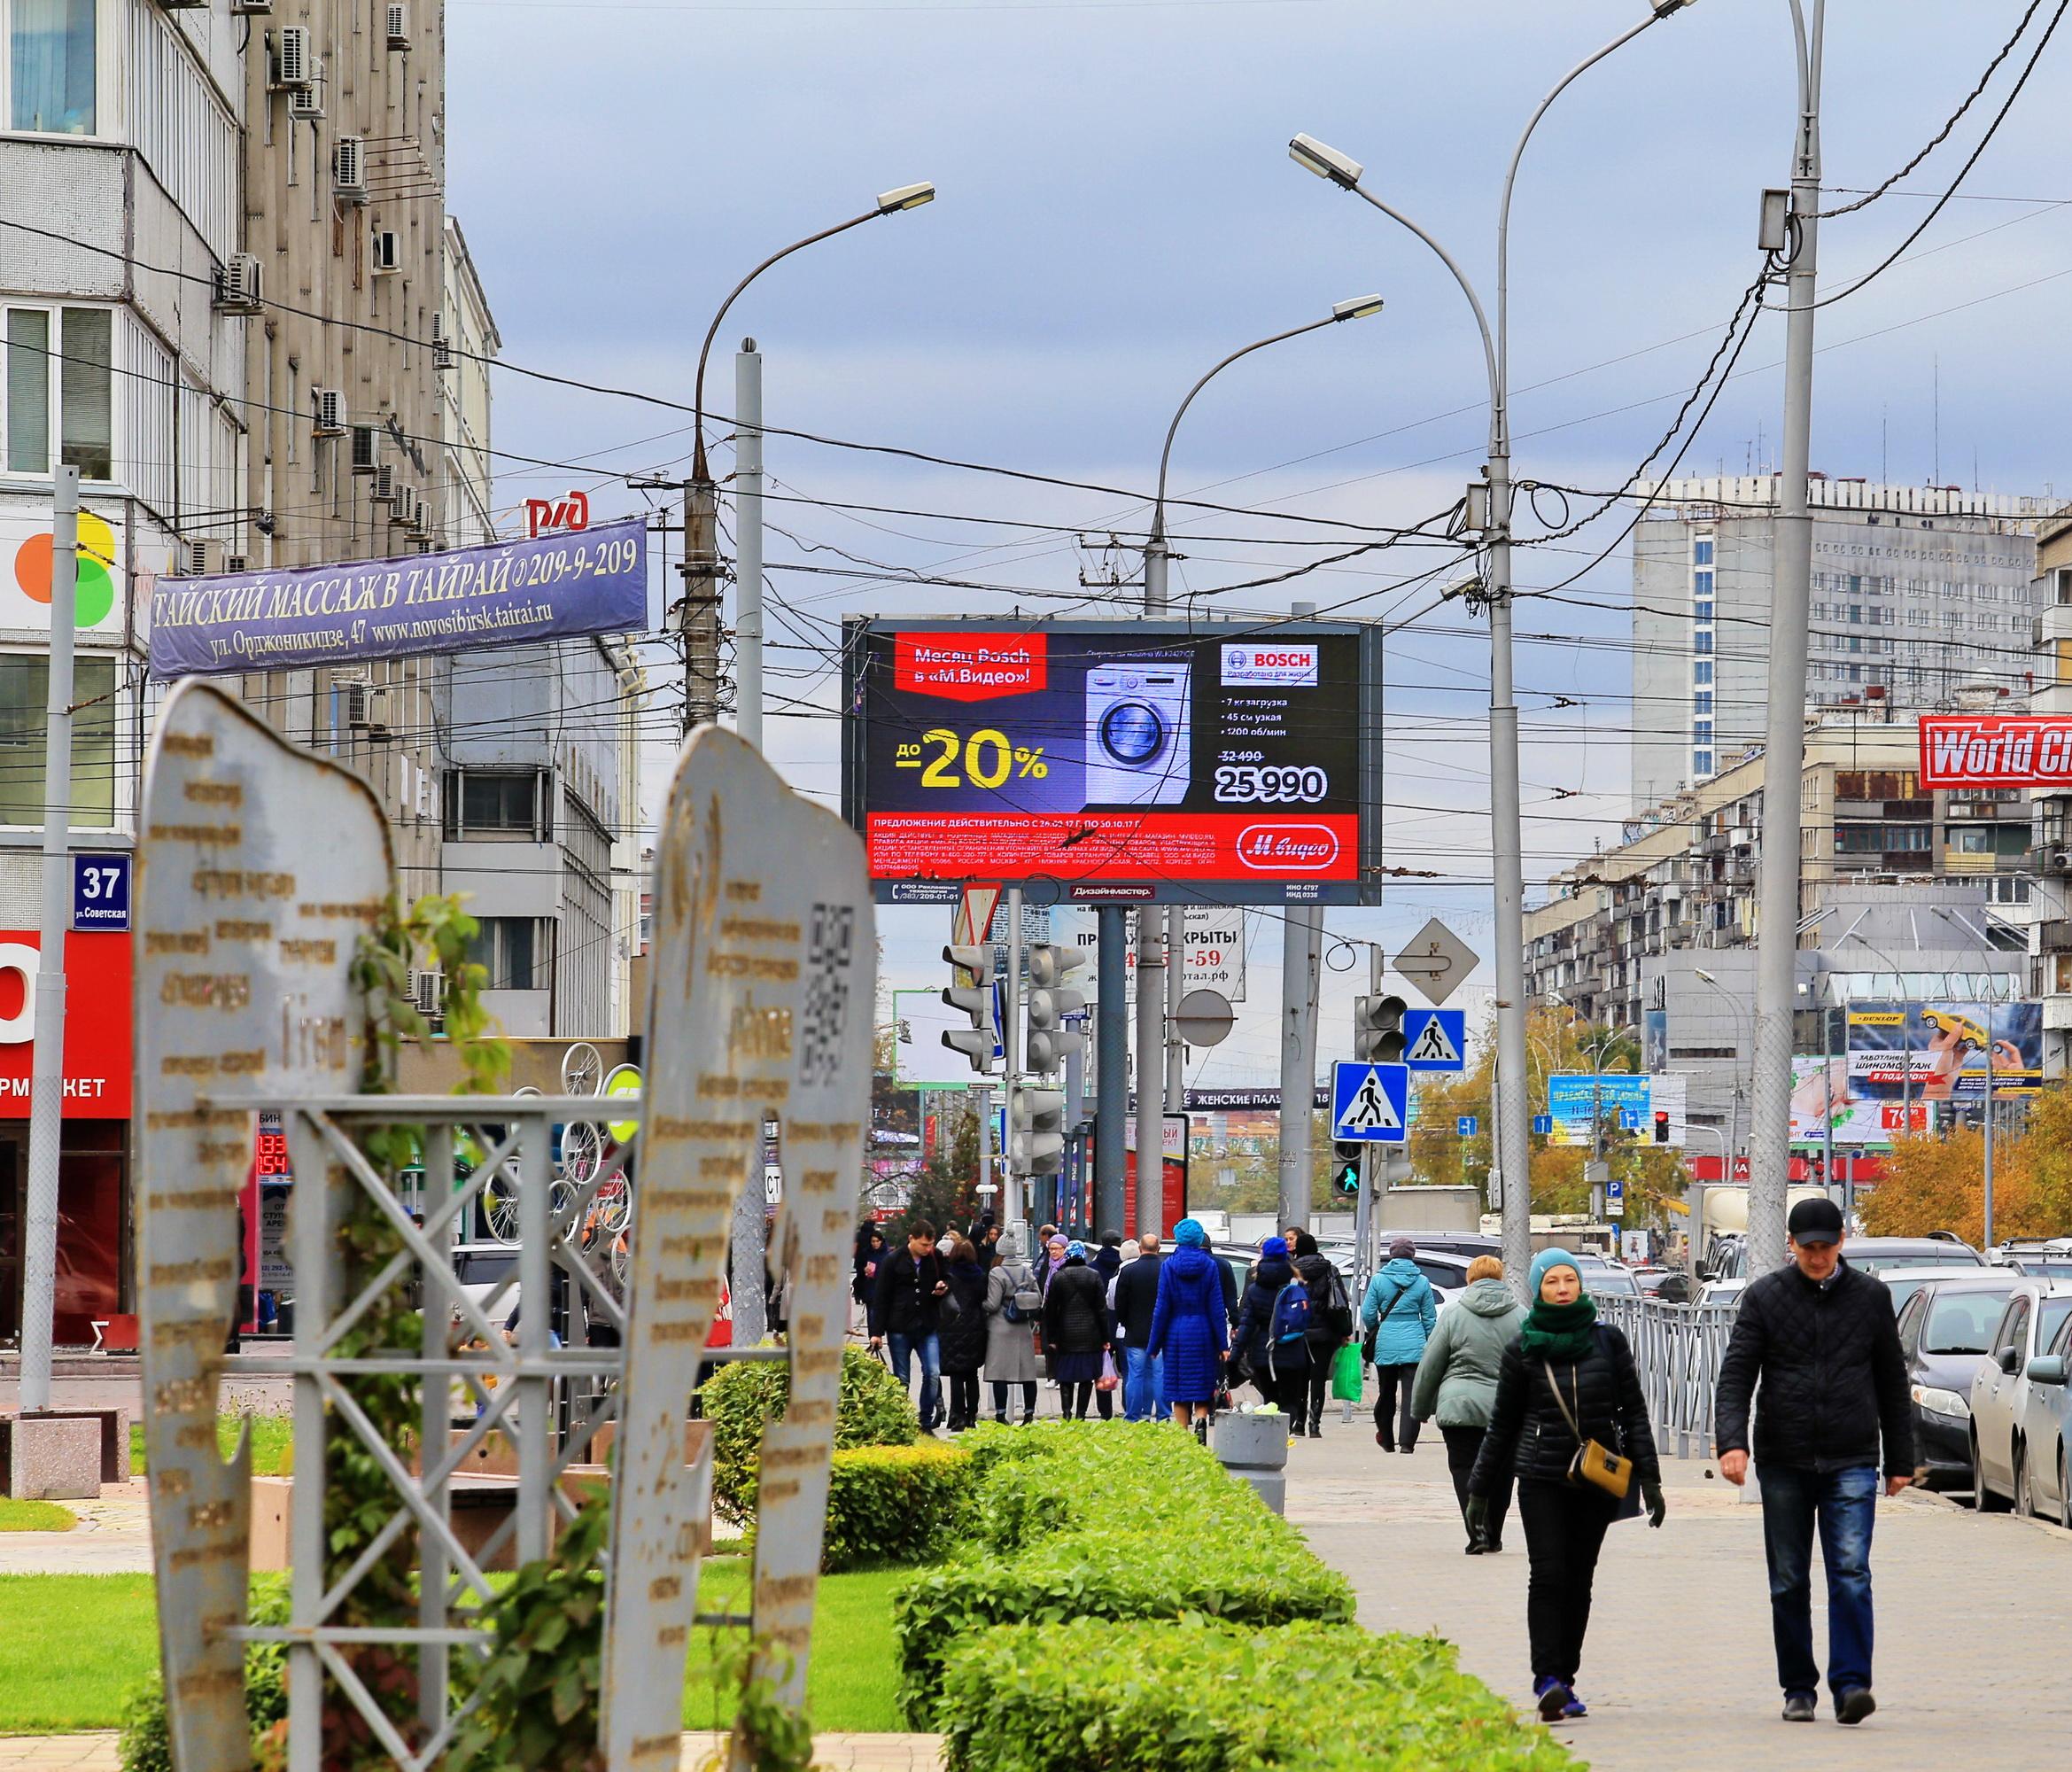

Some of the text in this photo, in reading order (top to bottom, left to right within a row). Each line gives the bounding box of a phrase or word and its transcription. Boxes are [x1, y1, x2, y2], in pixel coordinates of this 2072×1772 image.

[152, 538, 637, 628] ТАЙСКИЙ МАССАЖ В ТАЙРАЙ 209-9-209
[210, 633, 232, 664] ул.
[234, 623, 351, 656] Орджоникидзе,
[350, 618, 366, 643] 47
[371, 599, 554, 645] www.novosibirsk.tairai.ru
[914, 648, 1030, 665] Месяц Bosch
[1254, 653, 1311, 667] BOSCH
[928, 668, 1030, 686] «М.Видео»!
[1226, 712, 1238, 721] 45
[1254, 714, 1282, 724] узкая
[1250, 727, 1287, 736] об/мин
[896, 743, 921, 758] до
[1934, 729, 2072, 774] World Cl
[873, 819, 947, 828] ПРЕДЛОЖЕНИЕ
[948, 818, 1030, 829] ДЕЙСТВИТЕЛЬНО
[82, 867, 120, 898] 37
[84, 906, 127, 919] Советская
[1161, 930, 1237, 946] ОКРЫТЫ
[0, 1077, 105, 1097] РМКЕТ
[1197, 1093, 1251, 1105] ЖЕНСКИЕ
[1252, 1093, 1282, 1105] ПАЛЬ
